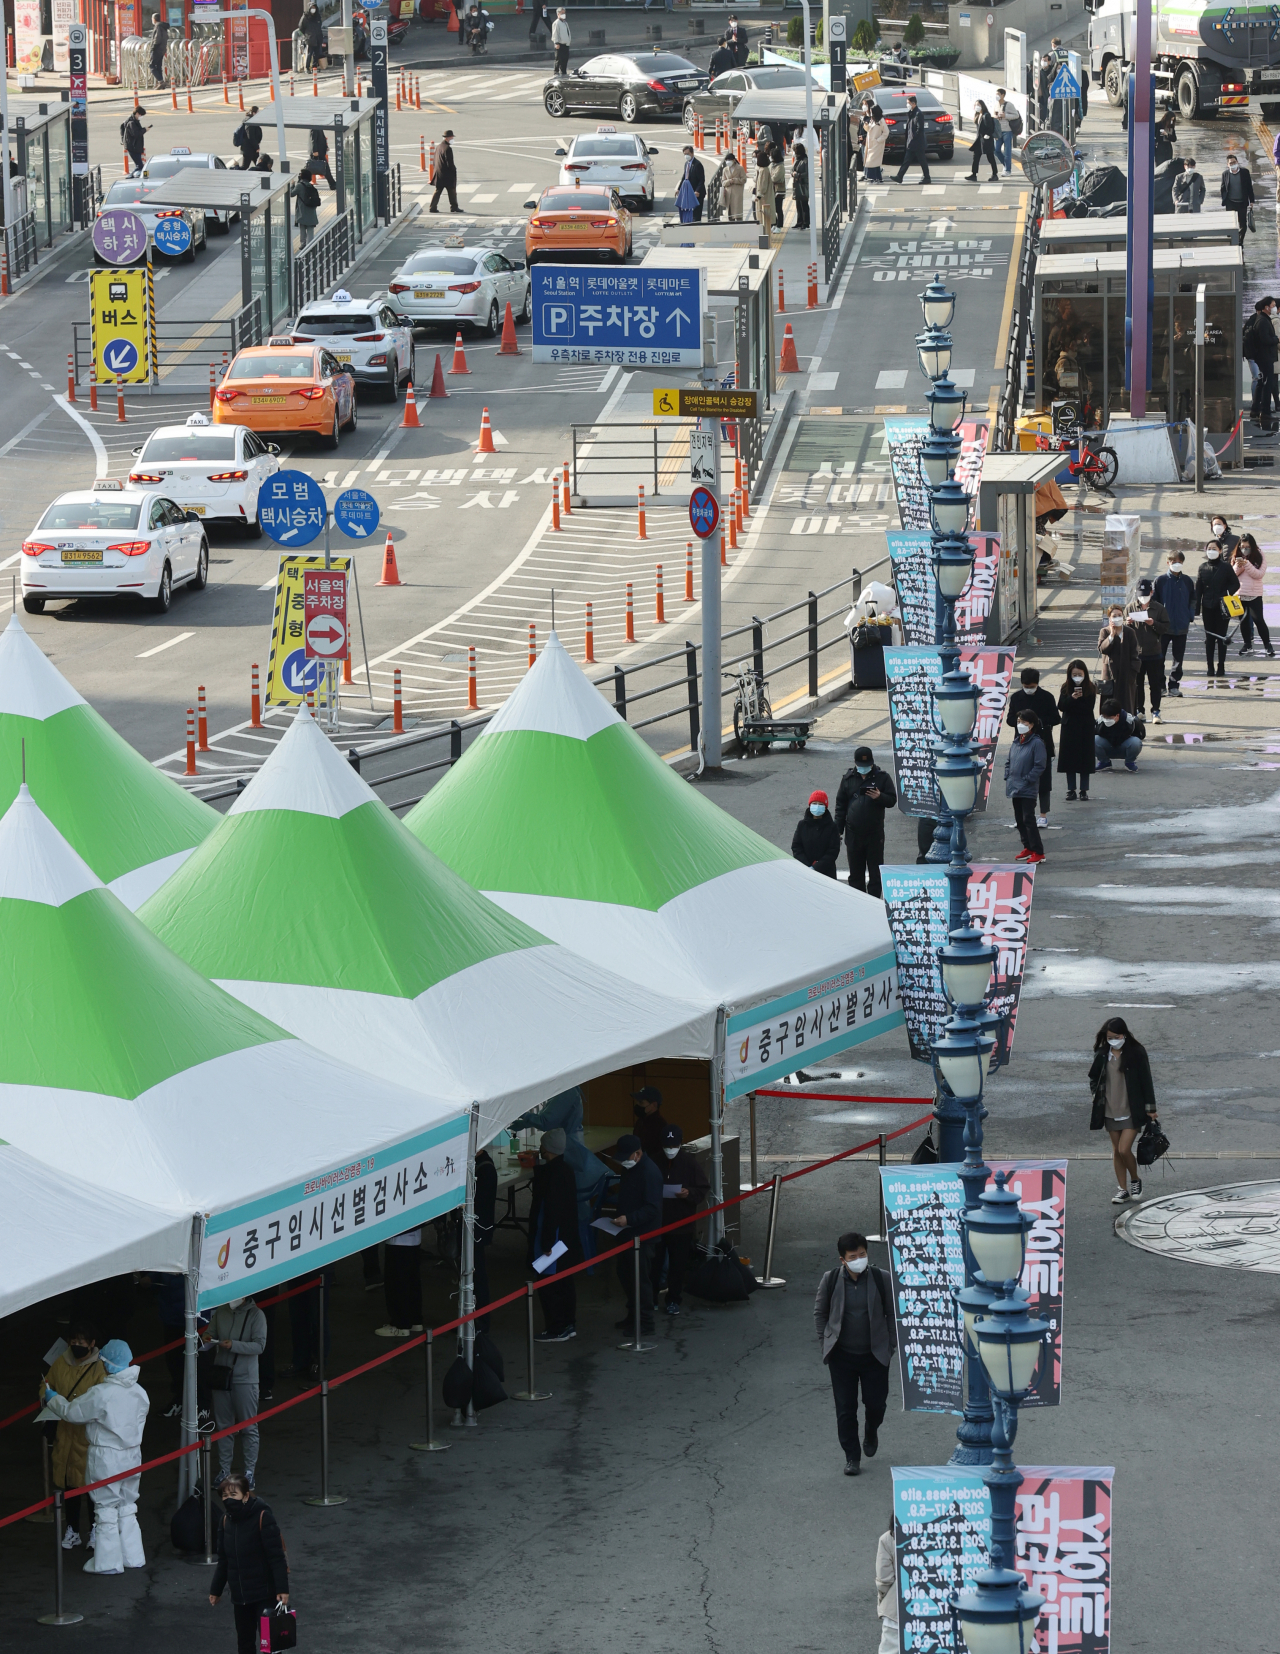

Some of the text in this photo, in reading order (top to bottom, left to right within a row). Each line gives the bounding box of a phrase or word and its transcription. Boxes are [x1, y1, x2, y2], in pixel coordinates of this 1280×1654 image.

[73, 54, 83, 70] 3
[374, 51, 385, 66] 2
[834, 46, 841, 62] 1
[376, 109, 386, 164] 택시내리는곳
[101, 215, 136, 233] 택시
[162, 221, 181, 231] 중형
[103, 234, 138, 251] 하차
[156, 231, 189, 242] 택시승차
[883, 240, 992, 254] 서울역
[859, 253, 1009, 269] 롯데마트
[873, 268, 993, 282] 아울렛
[542, 276, 691, 291] 서울역 롯데아울렛 롯데마트
[102, 309, 138, 327] 버스
[550, 304, 660, 339] P 주차장
[550, 348, 681, 364] 우측차로 주차장 전용 진입로
[684, 395, 752, 407] 장애인콜택시 승강장
[808, 461, 893, 479] 서울
[271, 482, 309, 500] 모범
[343, 491, 367, 500] 서울역
[386, 489, 521, 511] 승차
[261, 507, 323, 527] 택시승차
[340, 511, 372, 520] 롯데마트
[790, 514, 902, 535] 아울
[306, 579, 345, 594] 서울역
[306, 595, 345, 610] 주차장
[858, 966, 865, 978] 19
[303, 1162, 361, 1195] 코로나바이러스감염증
[367, 1157, 375, 1171] 19
[242, 1161, 428, 1269] 중구임시선별검사소
